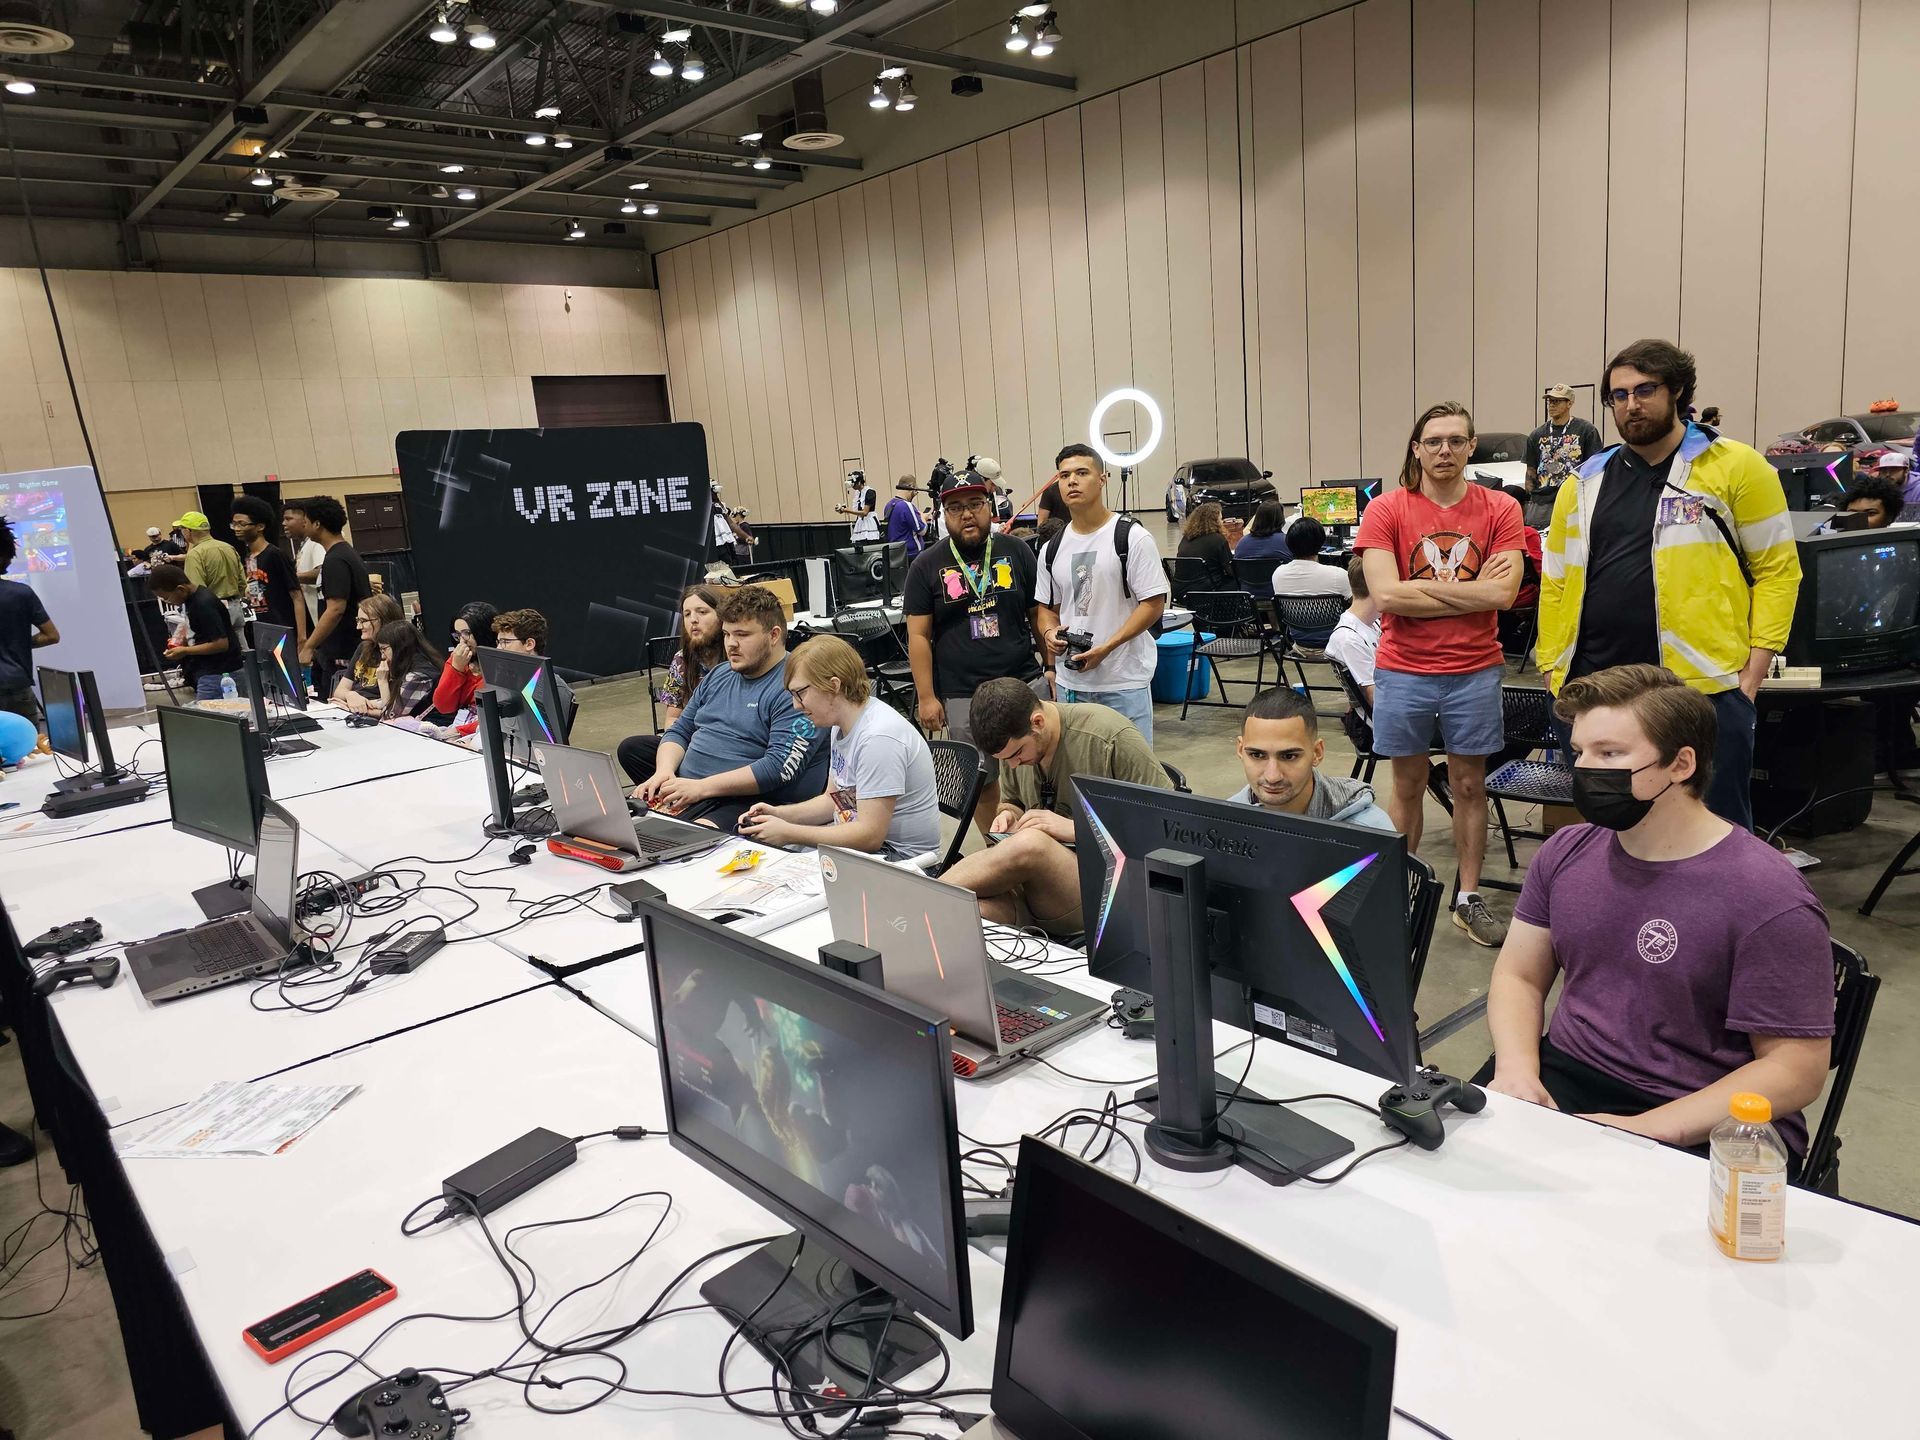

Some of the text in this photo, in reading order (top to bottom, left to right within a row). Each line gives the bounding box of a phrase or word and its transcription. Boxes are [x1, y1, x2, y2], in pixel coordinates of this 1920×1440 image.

[19, 482, 41, 490] Rhythm
[513, 476, 692, 524] VR ZONE
[1161, 819, 1259, 860] ViewSonic
